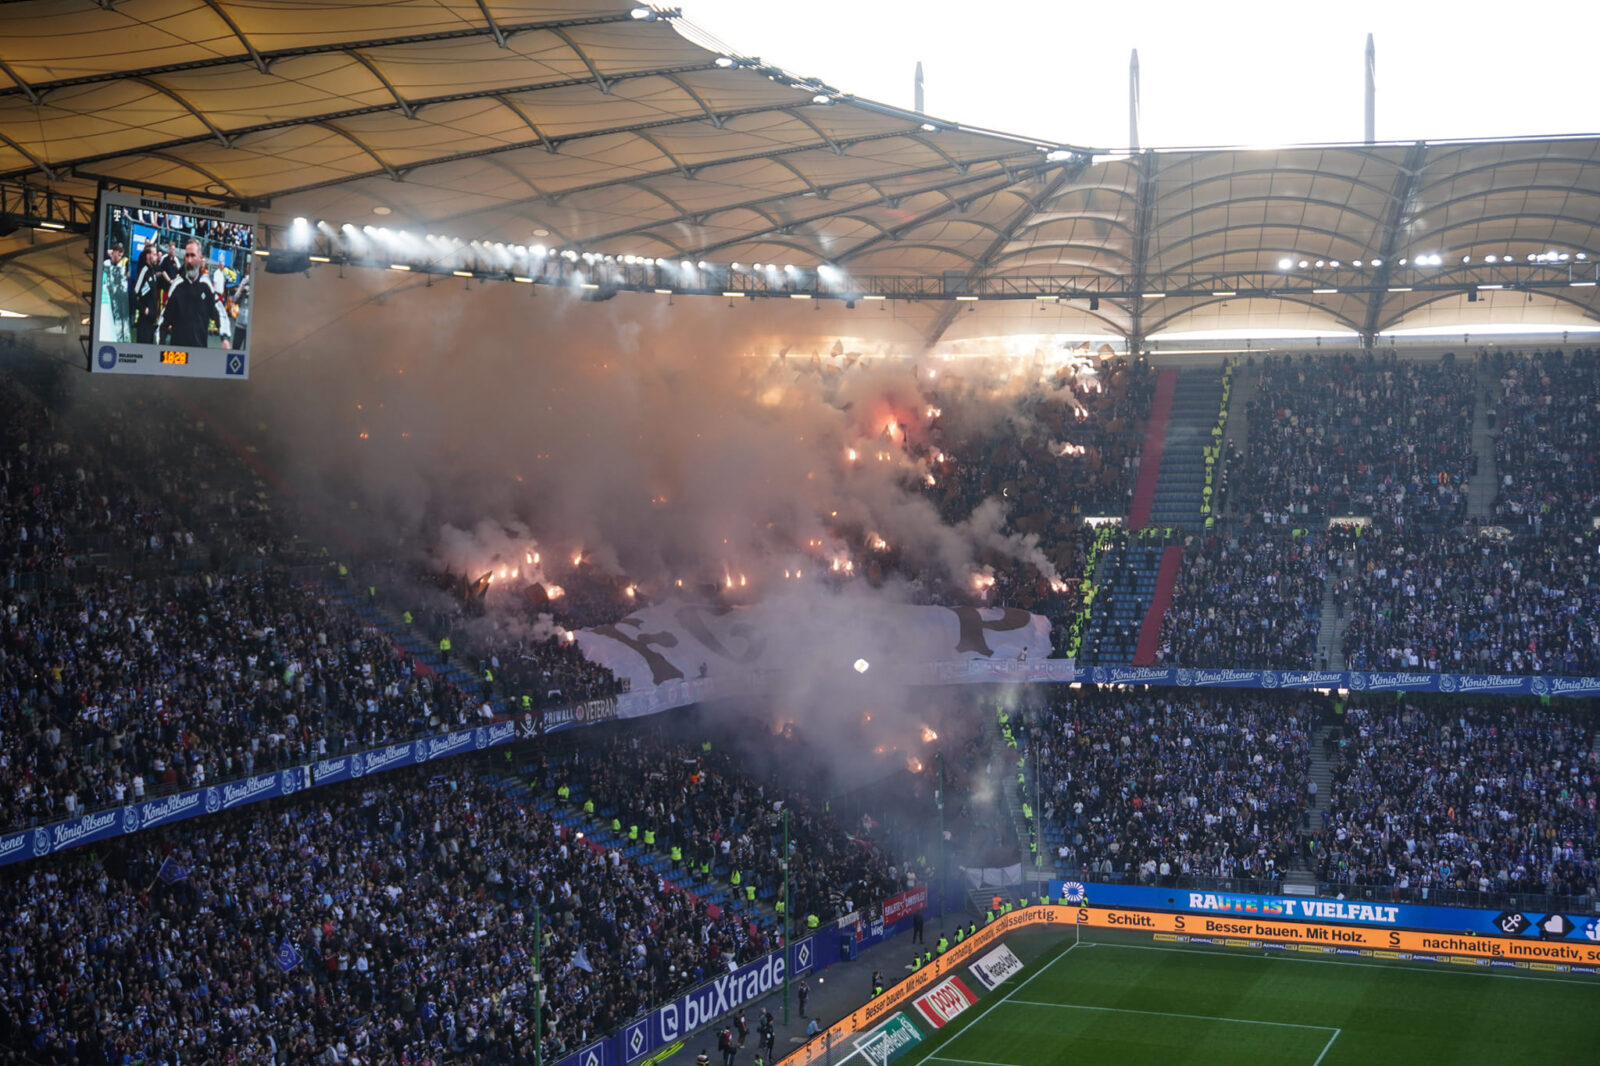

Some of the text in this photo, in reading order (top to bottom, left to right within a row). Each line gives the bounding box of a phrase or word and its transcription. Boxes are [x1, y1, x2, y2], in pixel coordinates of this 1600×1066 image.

[141, 198, 190, 213] WILLKOMMEN
[544, 706, 574, 725] PRIWALL
[1189, 892, 1399, 922] RAUTE IST VIELFALT
[1078, 908, 1089, 922] S
[1107, 912, 1155, 927] Schütt.
[1174, 915, 1185, 929] S
[1205, 919, 1253, 935] Besser
[1255, 923, 1303, 939] bauen.
[1306, 927, 1328, 940] Mit
[1332, 929, 1367, 943] Holz.
[1388, 931, 1400, 945] S
[1422, 938, 1505, 956] nachhaltig,
[1509, 942, 1583, 961] innovativ,
[685, 954, 785, 1033] buXtrade
[930, 983, 964, 1018] popp
[865, 1000, 885, 1021] Besser
